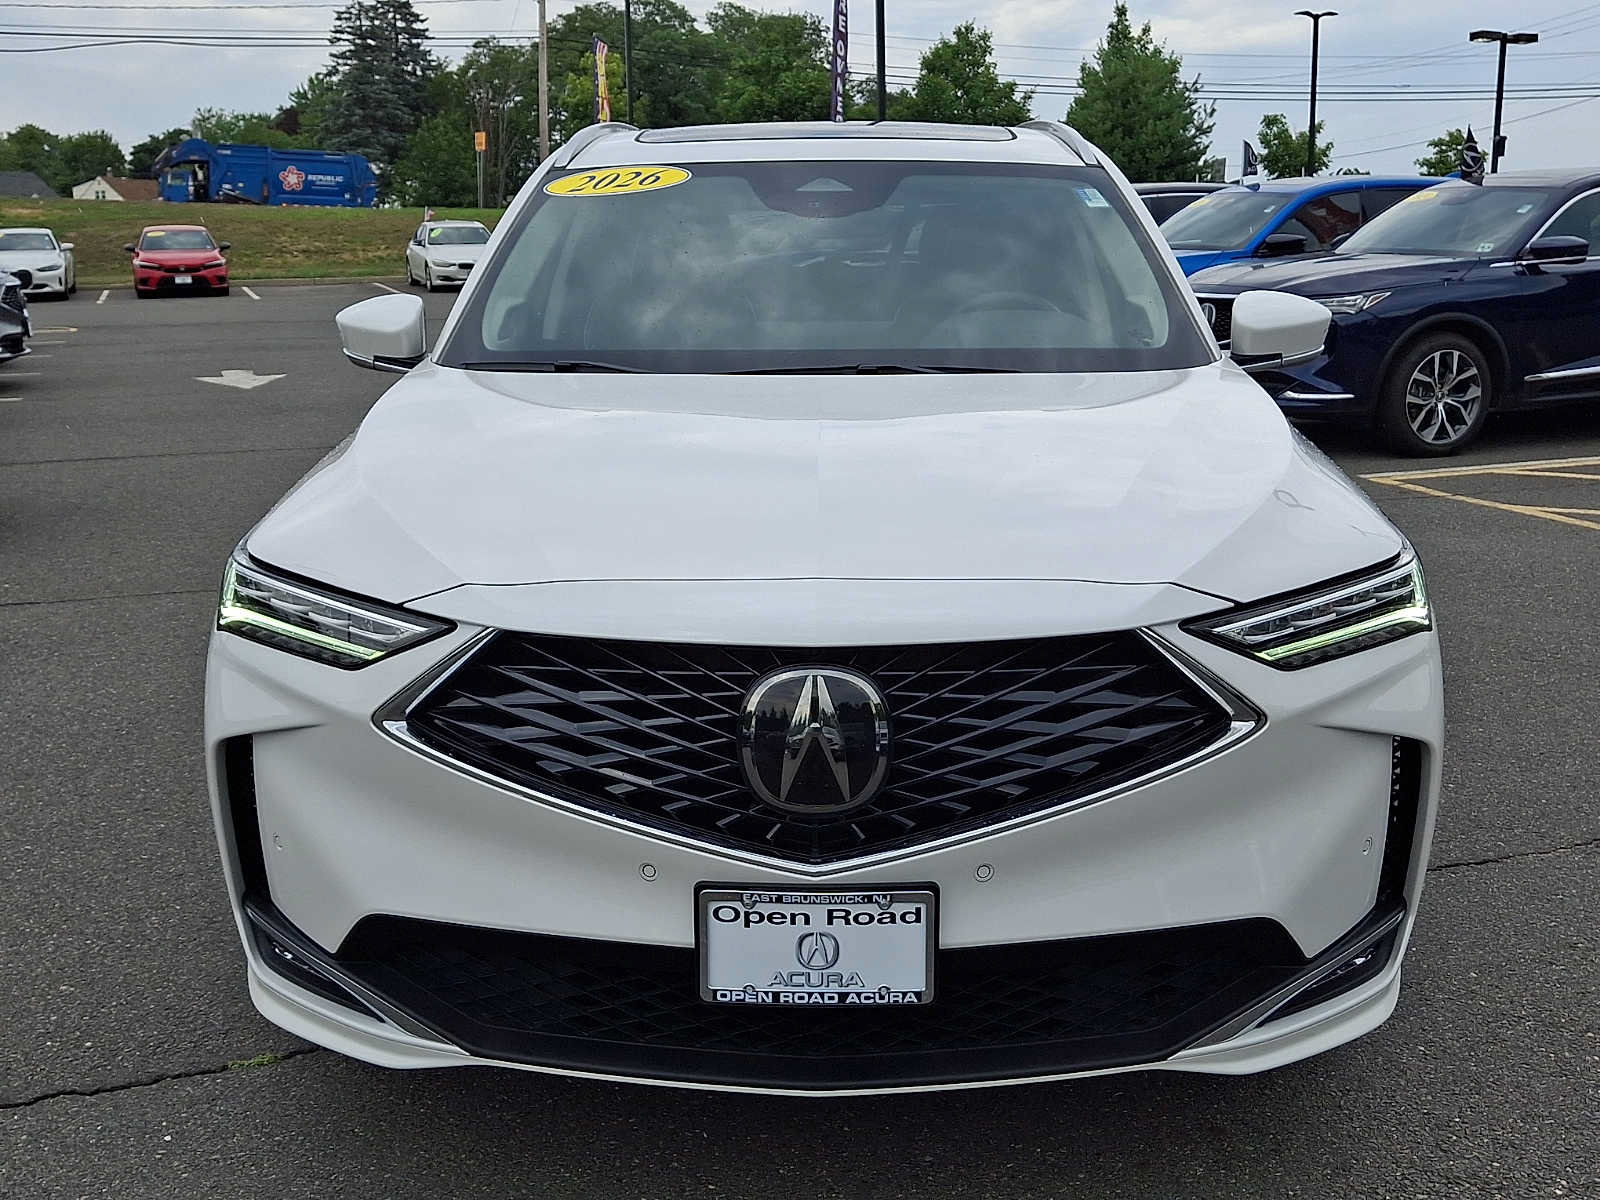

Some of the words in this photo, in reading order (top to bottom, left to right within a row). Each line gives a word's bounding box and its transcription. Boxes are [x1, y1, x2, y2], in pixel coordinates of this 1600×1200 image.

[566, 169, 669, 192] 2026
[743, 893, 778, 903] EAST
[873, 894, 891, 903] NJ
[712, 905, 811, 928] Open
[826, 906, 922, 926] Road
[767, 971, 866, 988] ACURA
[716, 990, 773, 1003] OPEN
[780, 992, 839, 1004] ROAD
[845, 992, 918, 1004] ACURA
